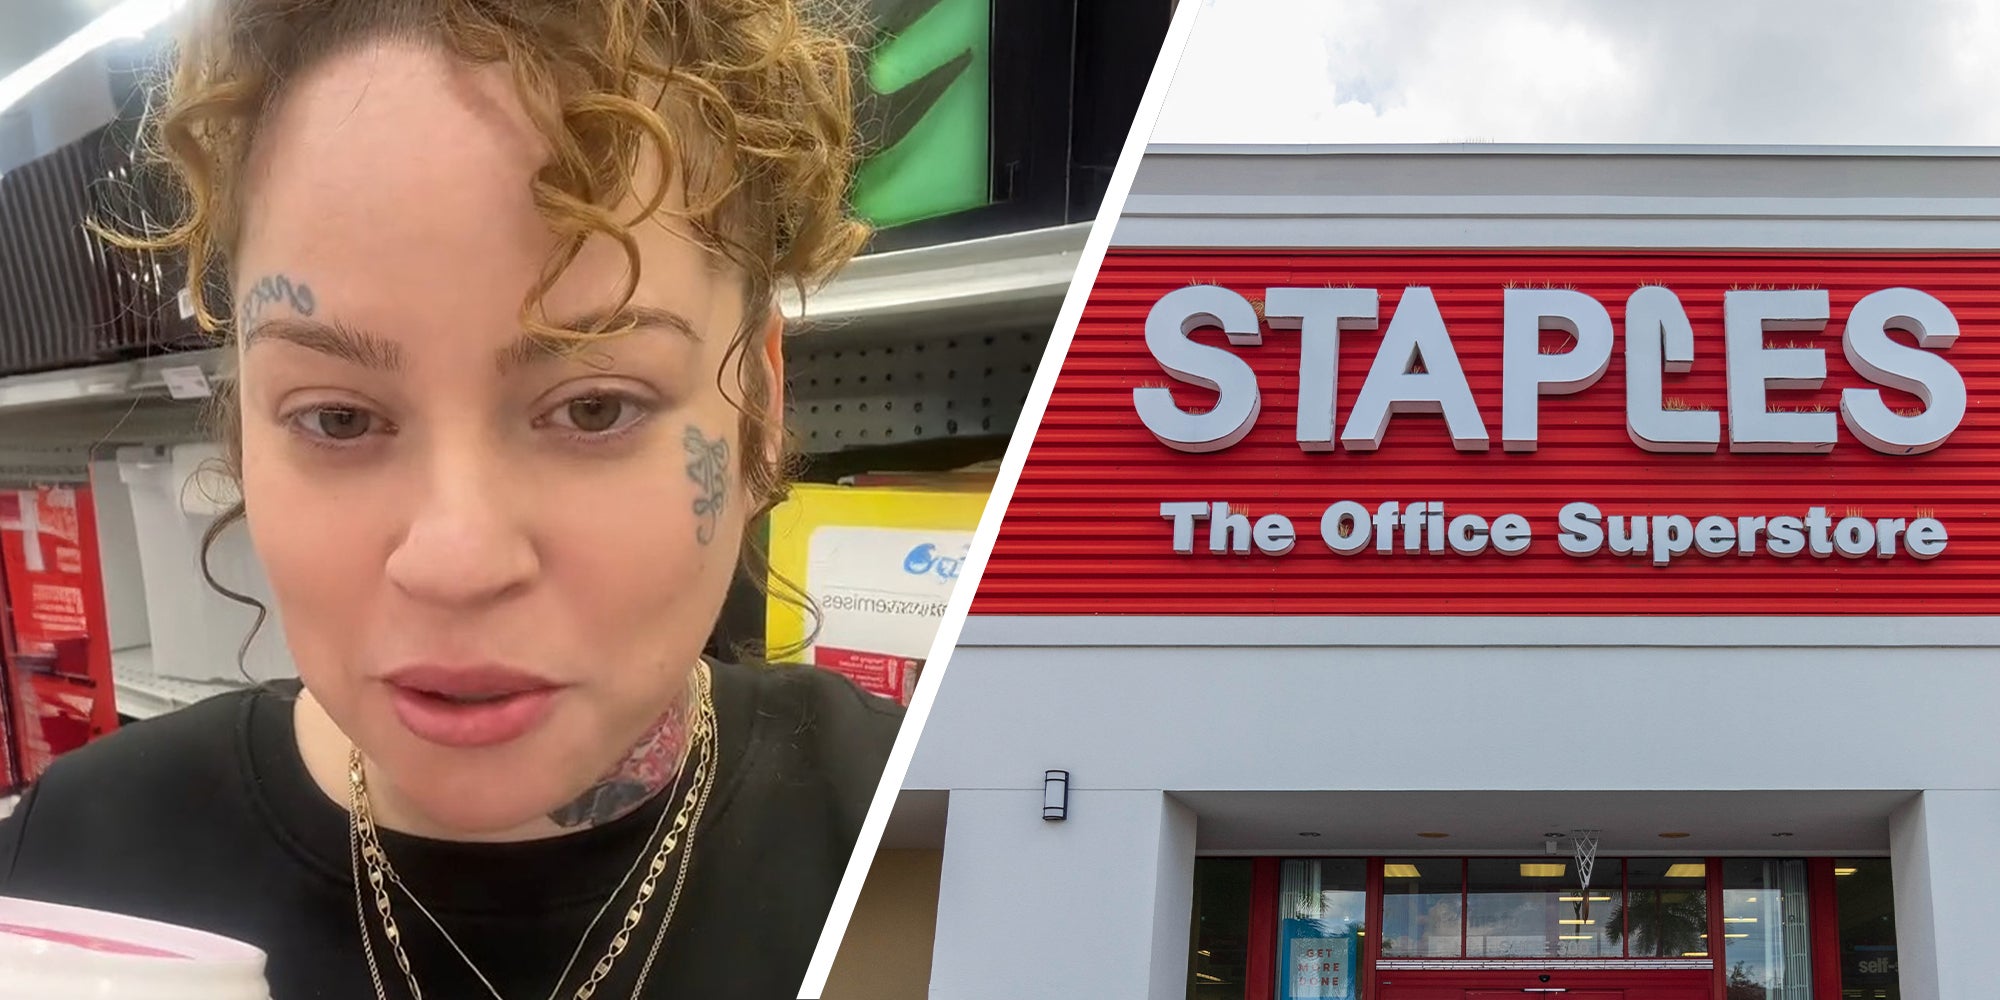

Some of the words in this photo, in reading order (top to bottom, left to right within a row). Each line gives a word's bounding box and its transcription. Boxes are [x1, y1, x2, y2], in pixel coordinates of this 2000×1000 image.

[1133, 285, 1967, 455] STAPLES
[1160, 501, 1296, 555] The
[1320, 500, 1532, 556] Office
[1557, 501, 1949, 567] Superstore
[1306, 949, 1333, 958] GET
[1298, 962, 1340, 972] MORE
[1298, 976, 1339, 986] DONE
